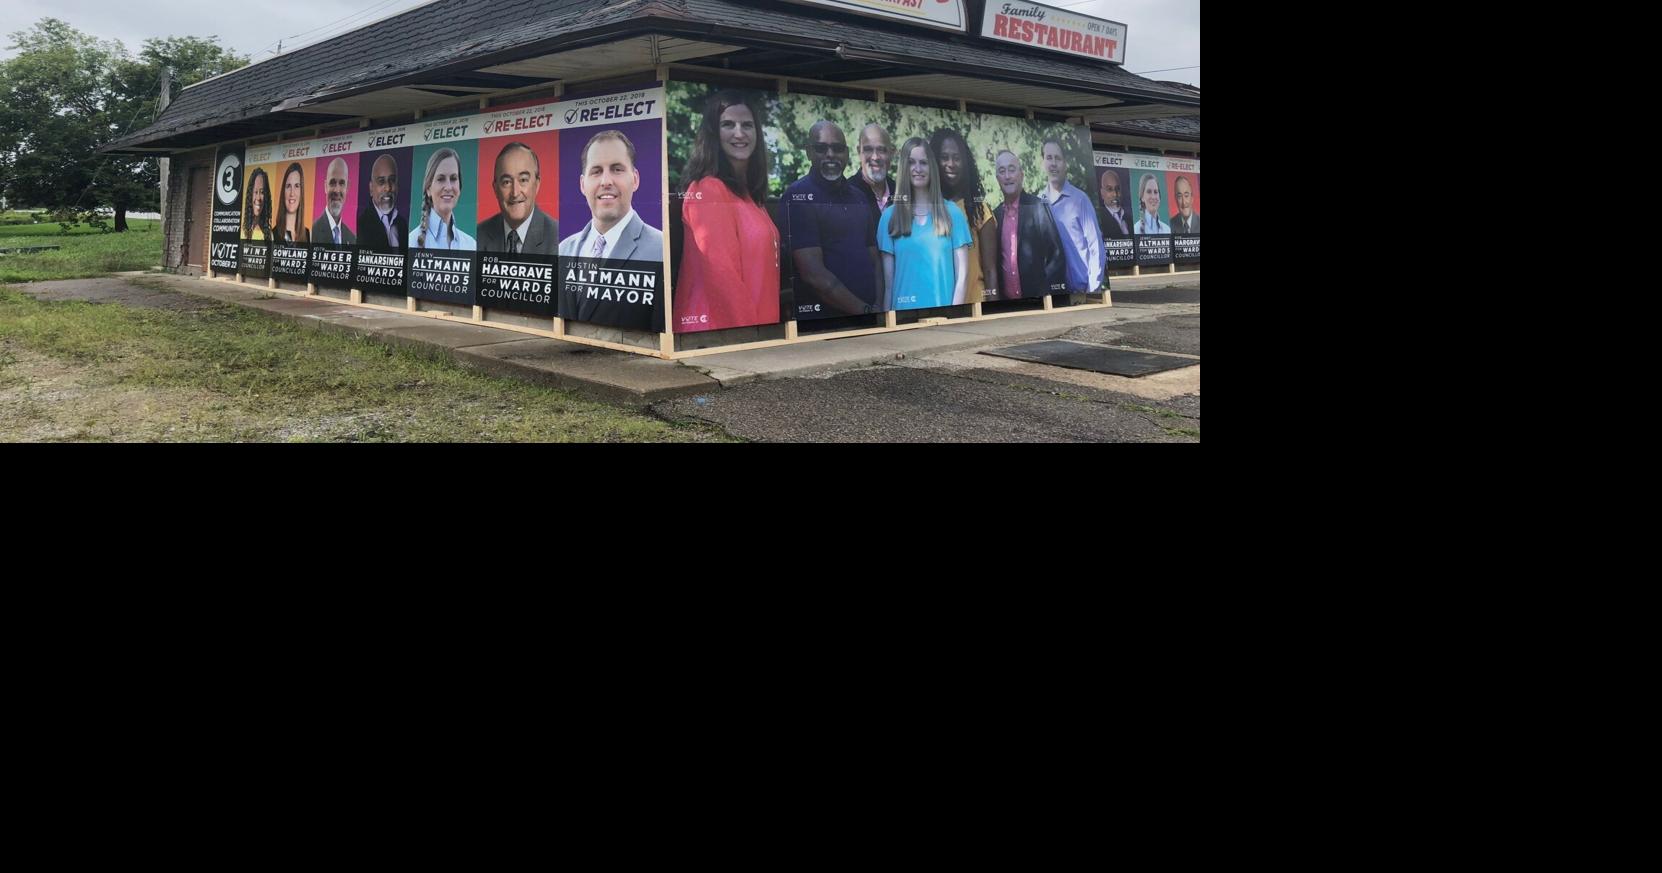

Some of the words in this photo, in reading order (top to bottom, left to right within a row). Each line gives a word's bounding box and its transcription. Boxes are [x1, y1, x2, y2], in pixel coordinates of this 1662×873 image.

[1000, 3, 1046, 20] Family
[1087, 22, 1100, 32] OPEN
[1105, 26, 1118, 36] DAYS
[993, 14, 1117, 58] RESTAURANT
[590, 96, 618, 105] OCTOBER
[503, 109, 525, 117] OCTOBER
[579, 100, 656, 122] RE-ELECT
[494, 113, 553, 132] RE-ELECT
[433, 125, 468, 140] ELECT
[375, 133, 405, 147] ELECT
[288, 147, 310, 158] ELECT
[328, 141, 353, 153] ELECT
[1102, 157, 1123, 166] ELECT
[1140, 160, 1160, 169] ELECT
[1171, 162, 1195, 171] RE-ELECT
[213, 225, 240, 233] COMMUNITY
[211, 242, 238, 259] VOTE
[243, 247, 267, 256] WINT
[272, 249, 308, 259] GOWLAND
[247, 257, 263, 265] WARD
[312, 251, 353, 263] SINGER
[358, 254, 404, 267] SANKARSINGH
[211, 259, 231, 268] OCTOBER
[280, 260, 301, 268] WARD
[302, 260, 307, 269] 2
[320, 263, 345, 273] WARD
[345, 264, 351, 273] 3
[412, 258, 470, 272] ALTMANN
[566, 261, 599, 270] JUSTIN
[272, 266, 306, 275] COUNCILLOR
[311, 270, 350, 280] COUNCILLOR
[367, 267, 396, 278] WARD
[397, 269, 404, 278] 4
[482, 263, 553, 280] HARGRAVE
[356, 275, 403, 286] COUNCILLOR
[425, 272, 460, 285] WARD
[462, 275, 470, 286] 5
[565, 268, 656, 288] ALTMANN
[411, 281, 468, 294] COUNCILLOR
[500, 279, 541, 293] WARD
[544, 283, 552, 294] 6
[481, 288, 551, 304] COUNCILLOR
[565, 284, 583, 293] FOR
[586, 286, 654, 306] MAYOR
